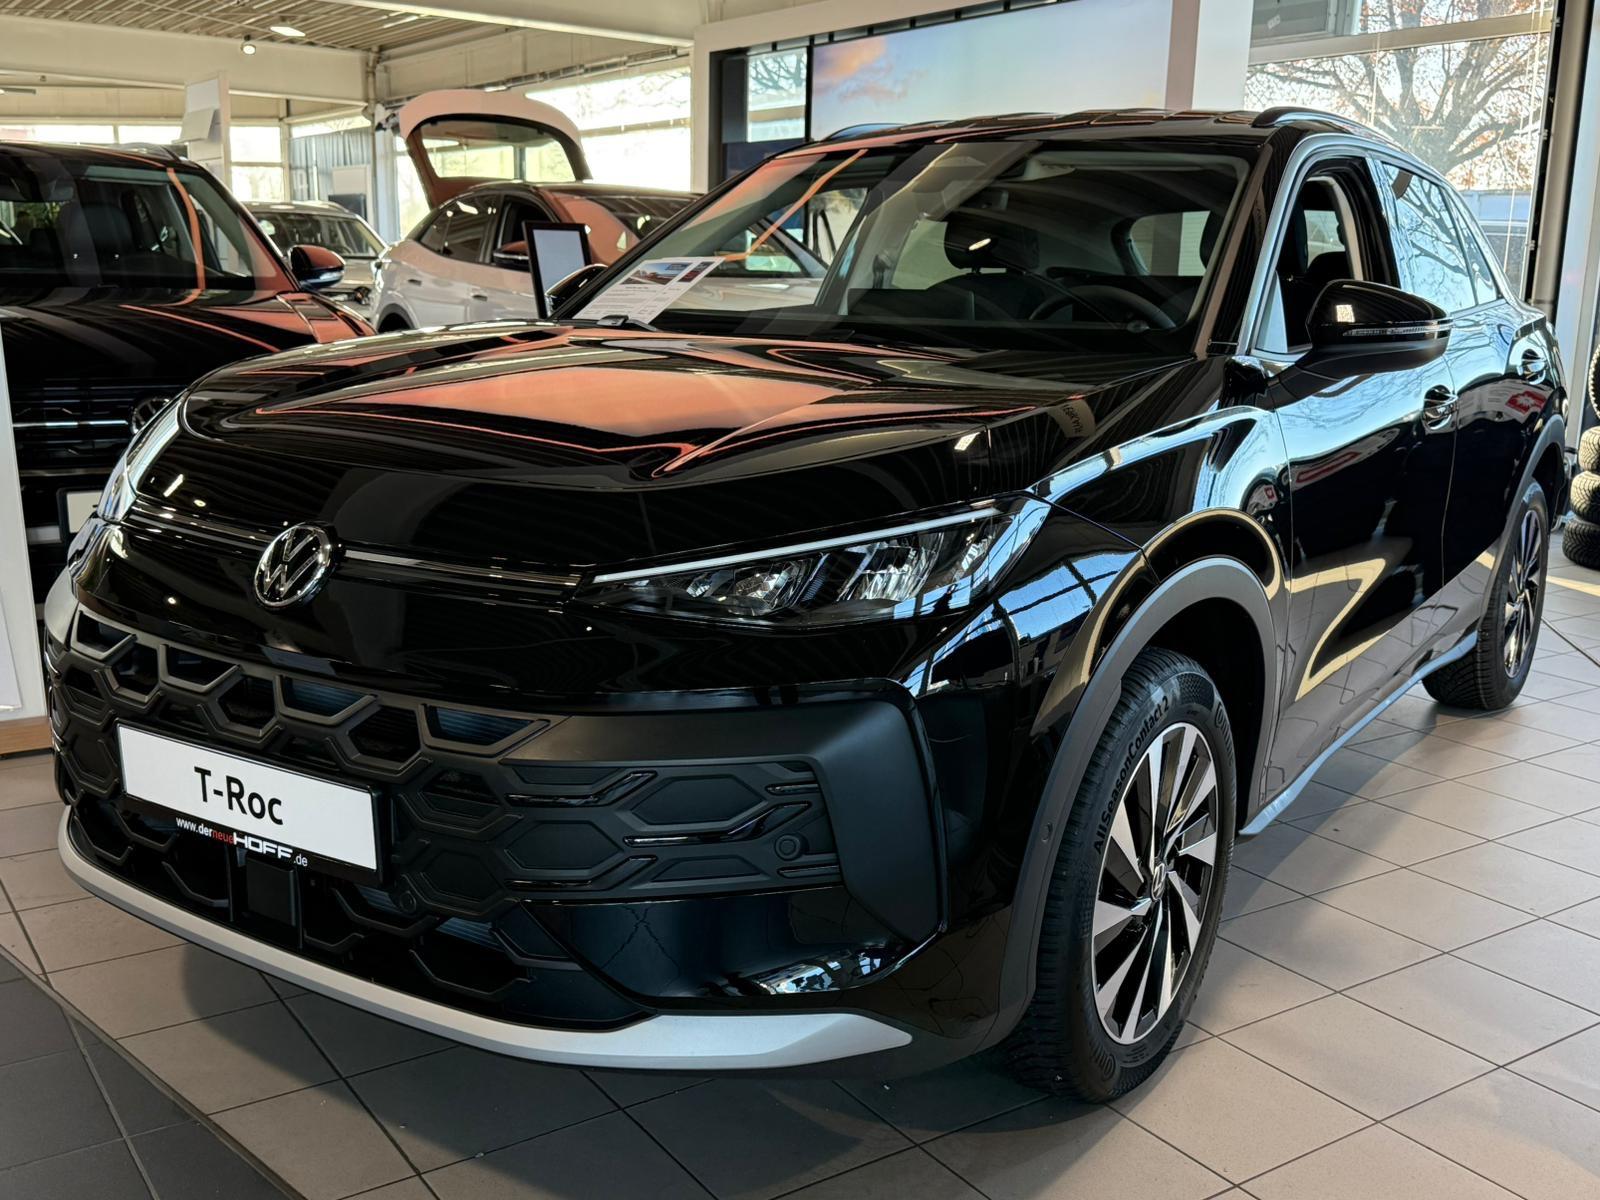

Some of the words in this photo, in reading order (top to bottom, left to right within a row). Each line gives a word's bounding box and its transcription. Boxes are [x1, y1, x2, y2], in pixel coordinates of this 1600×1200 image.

[194, 766, 284, 825] T-Roc
[1093, 706, 1164, 855] AllSeasonContact
[1162, 695, 1170, 712] 2
[176, 817, 308, 867] www.derneueHOFF.de
